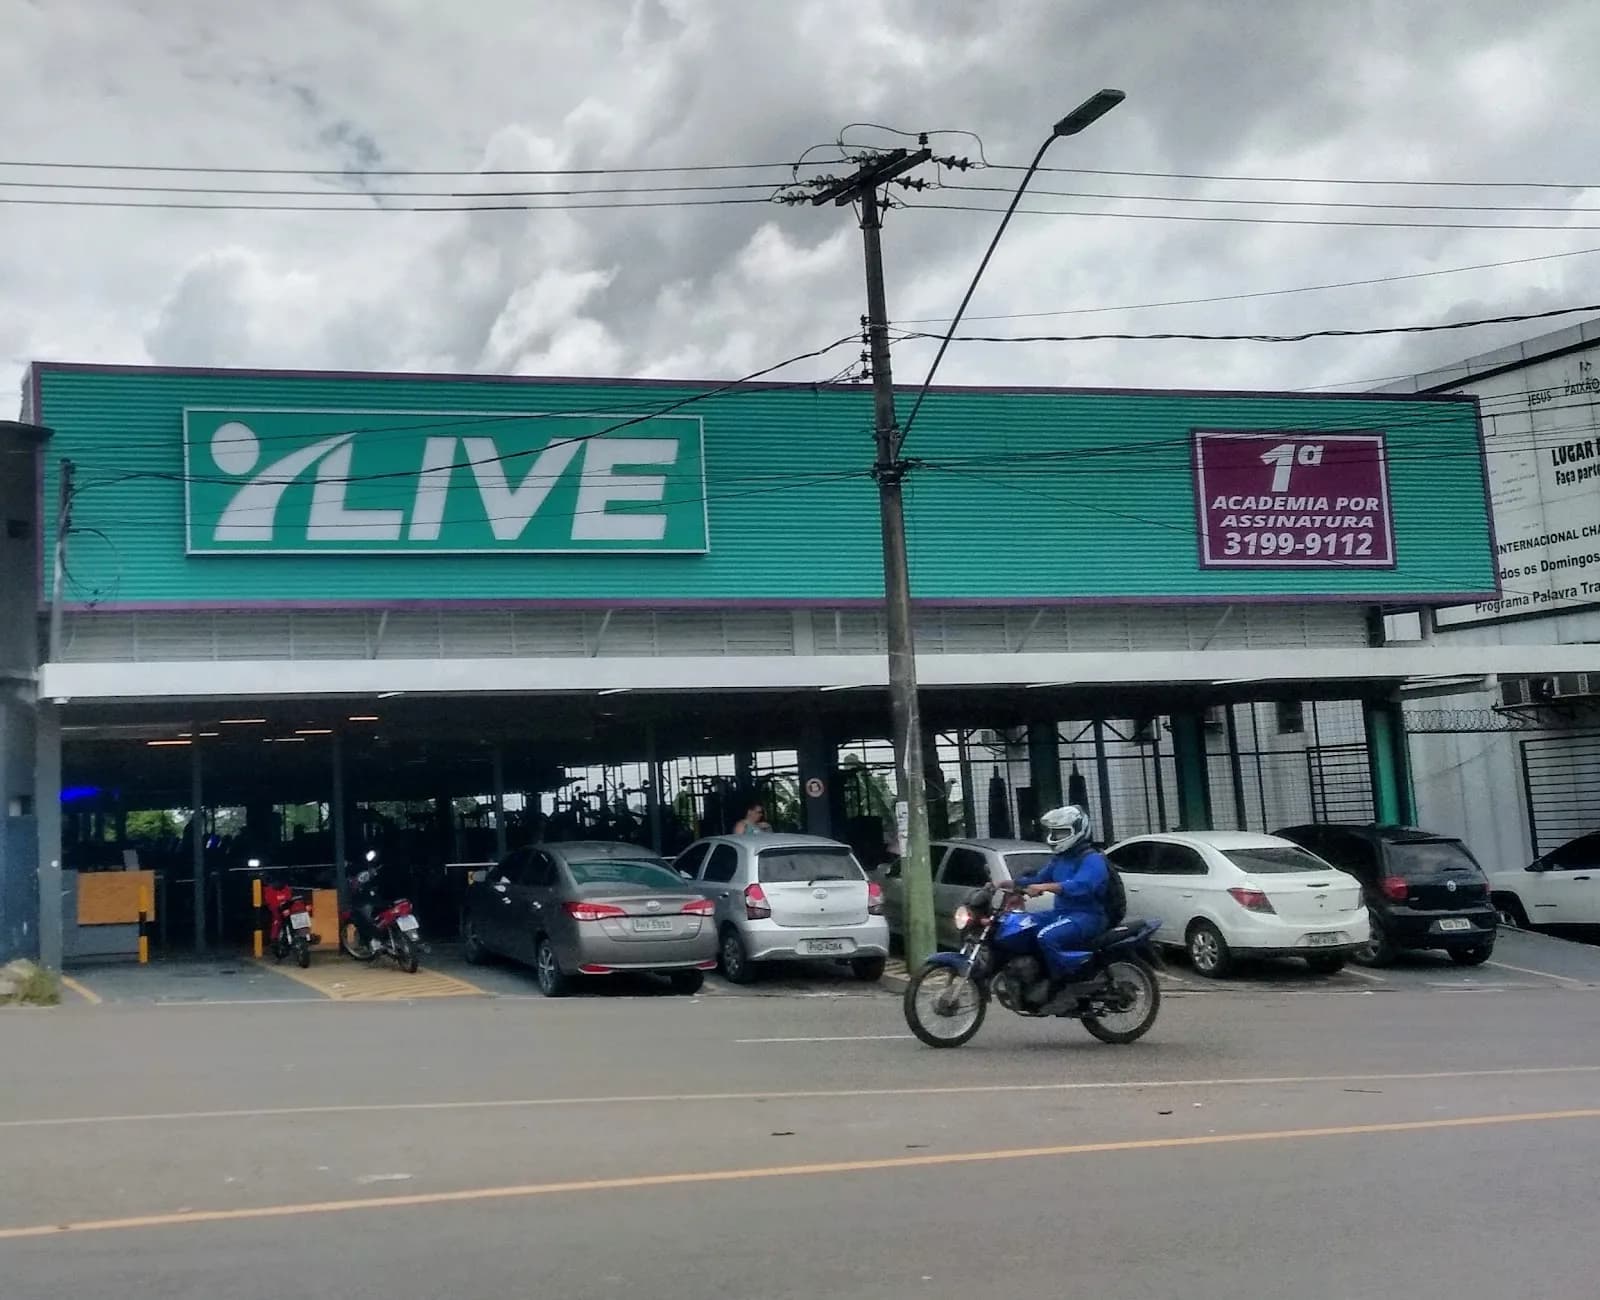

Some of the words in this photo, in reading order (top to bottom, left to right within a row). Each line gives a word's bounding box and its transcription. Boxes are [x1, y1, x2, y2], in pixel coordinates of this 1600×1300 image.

[1528, 391, 1552, 406] JESUS
[1551, 440, 1594, 467] LUGAR
[1555, 470, 1575, 486] Faça
[1211, 496, 1329, 511] ACADEMIA
[1335, 497, 1379, 511] POR
[1220, 515, 1374, 528] ASSINATURA
[1224, 532, 1373, 556] 3199-9112
[1497, 529, 1579, 555] INTERNACIONAL
[1524, 565, 1537, 575] os
[1541, 552, 1600, 572] Domingos
[1475, 595, 1529, 614] Programa
[1533, 587, 1577, 603] Palavra
